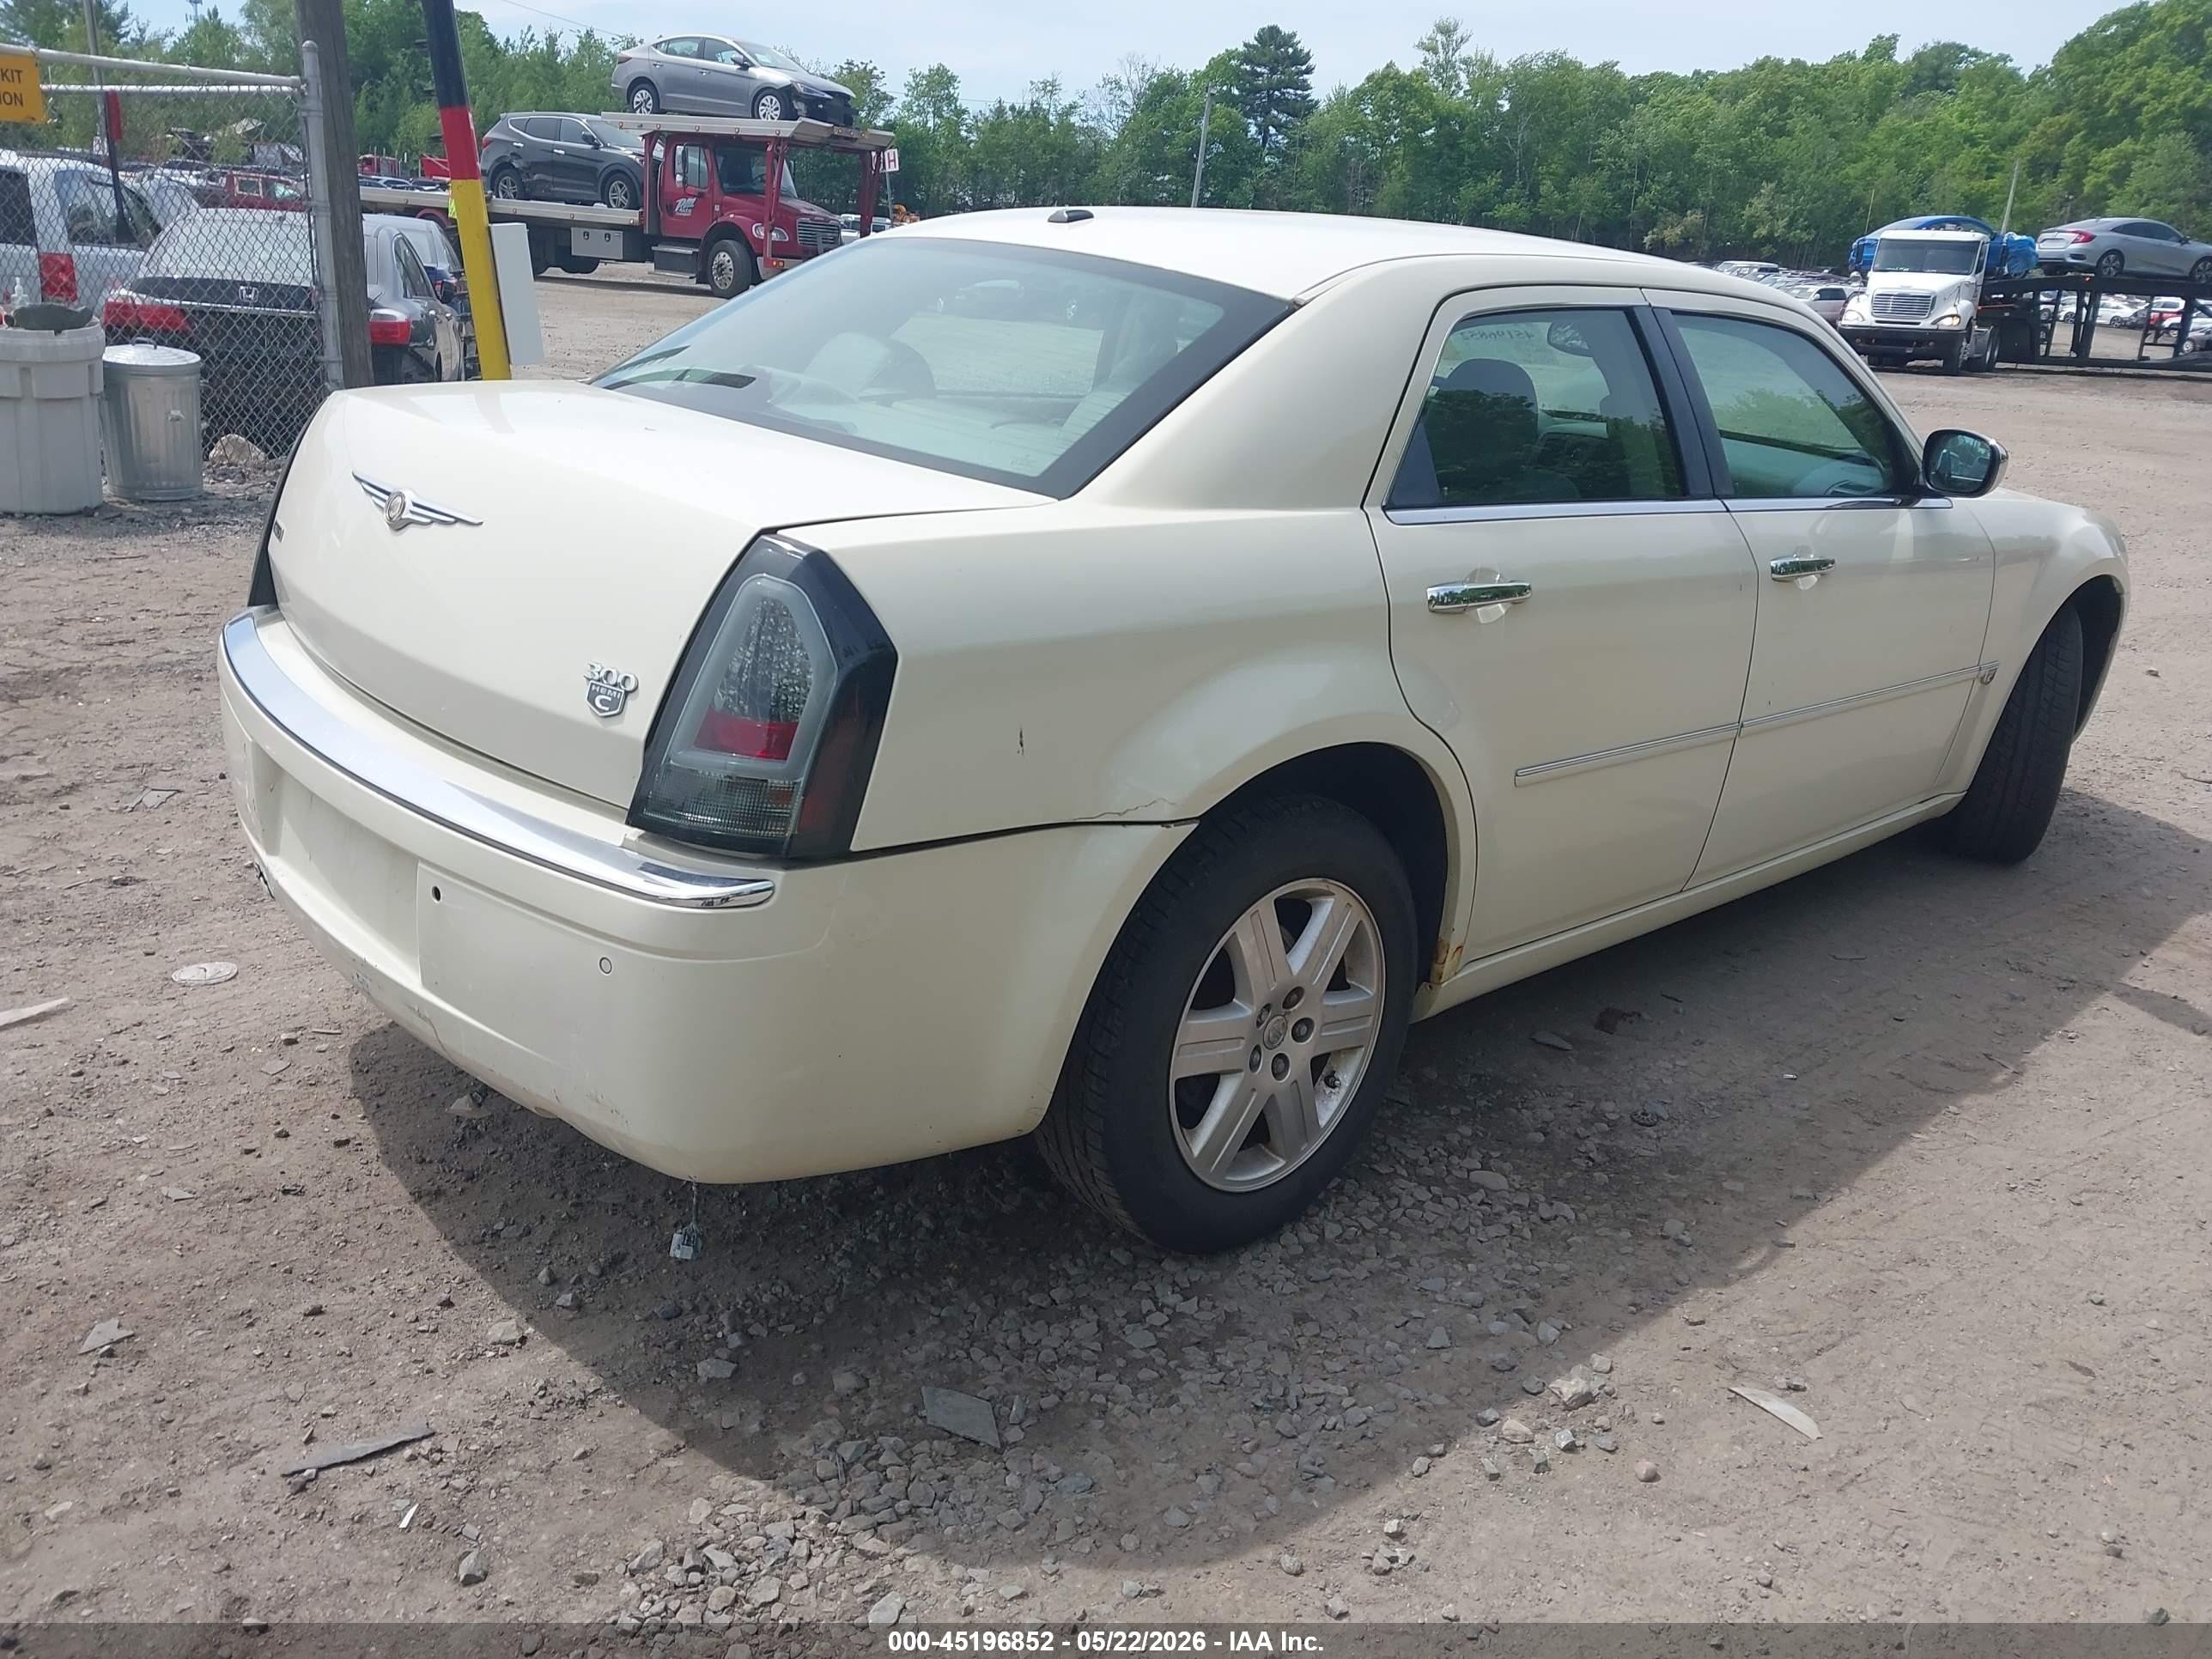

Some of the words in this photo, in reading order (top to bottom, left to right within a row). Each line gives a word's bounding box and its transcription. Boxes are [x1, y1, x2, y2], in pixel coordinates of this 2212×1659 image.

[0, 68, 23, 84] KIT
[583, 660, 639, 692] 300
[591, 684, 622, 699] HEMI
[594, 695, 612, 711] C
